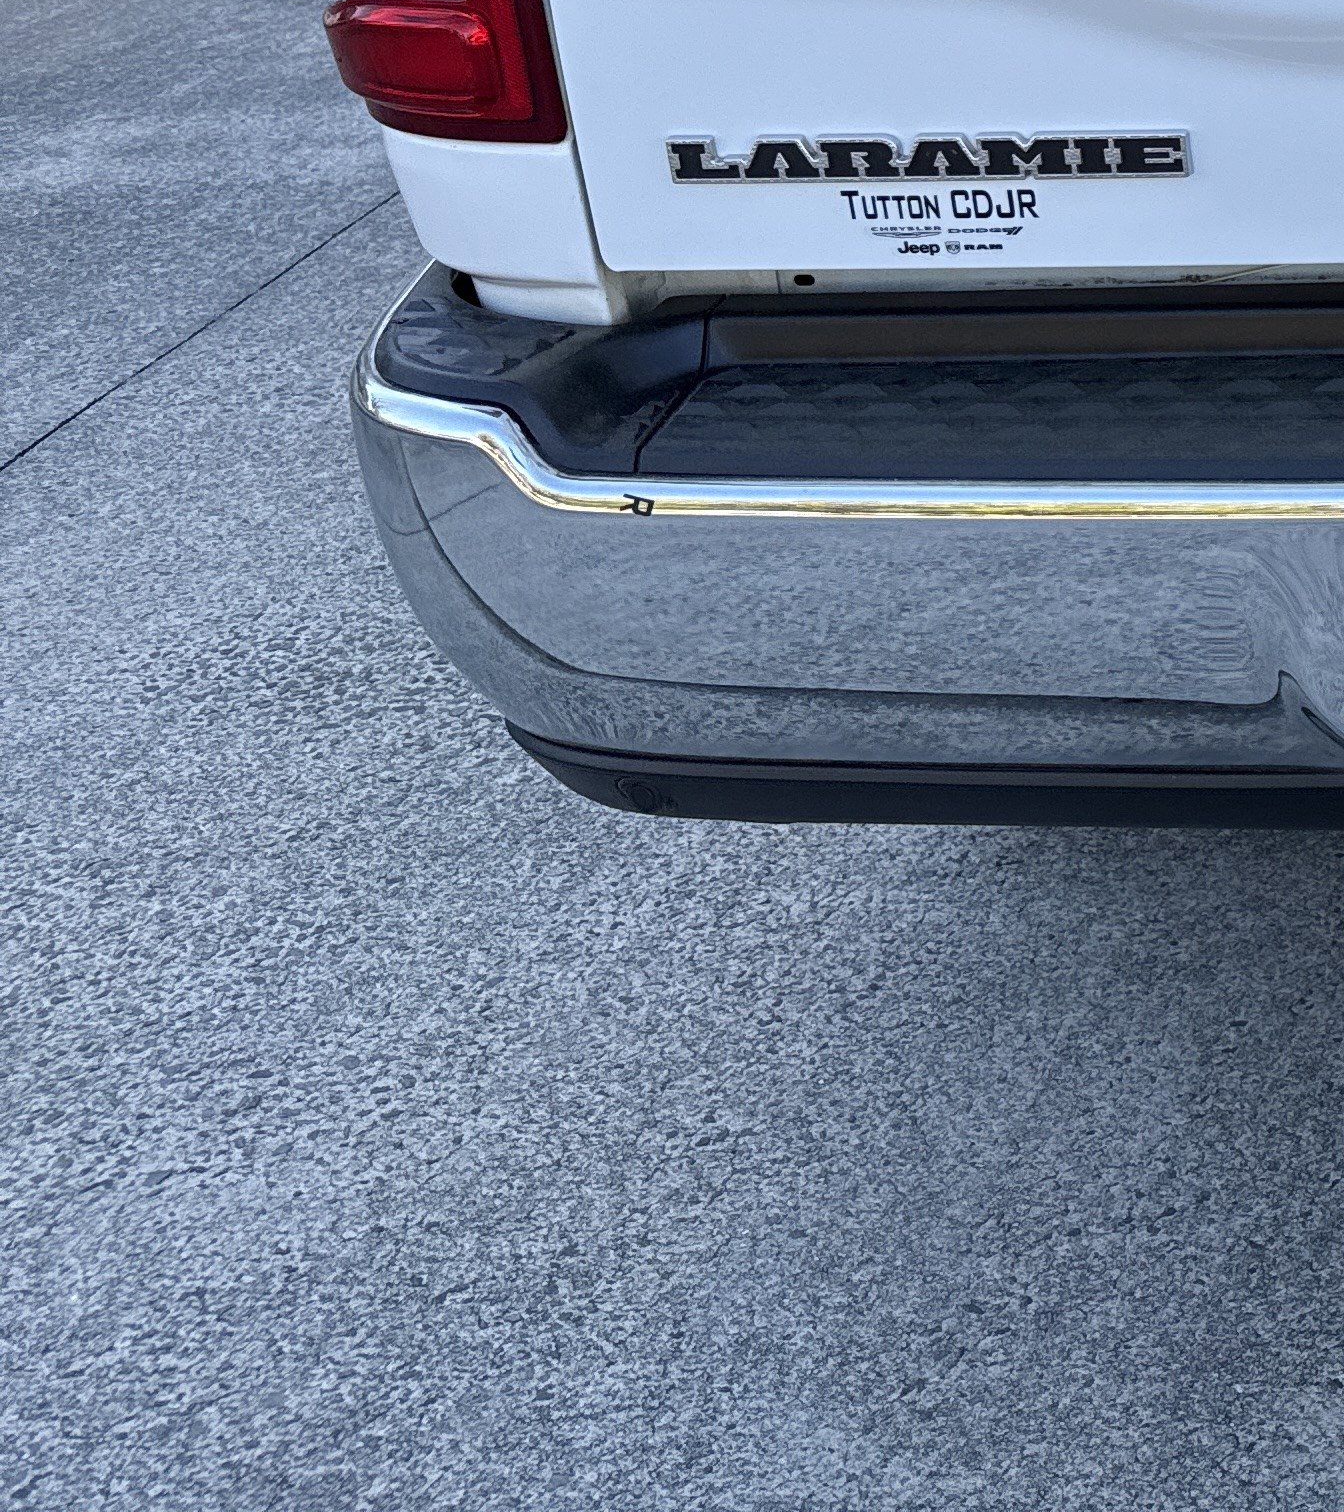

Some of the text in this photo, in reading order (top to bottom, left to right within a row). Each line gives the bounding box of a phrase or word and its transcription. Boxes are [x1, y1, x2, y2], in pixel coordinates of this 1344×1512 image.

[666, 128, 1191, 184] LARAMIE
[951, 189, 1039, 219] CDJR
[897, 241, 1003, 255] Jeep RAM
